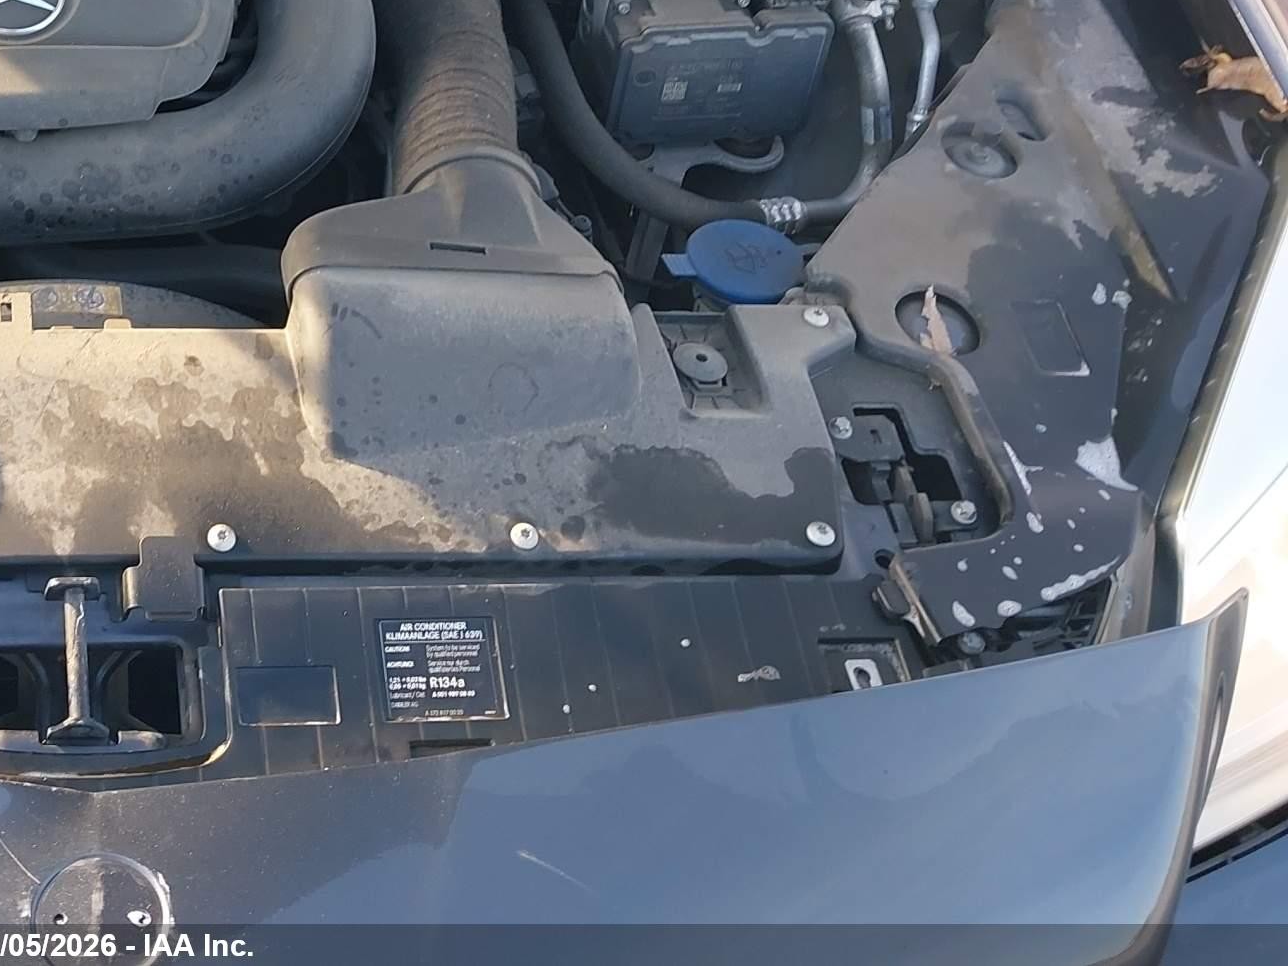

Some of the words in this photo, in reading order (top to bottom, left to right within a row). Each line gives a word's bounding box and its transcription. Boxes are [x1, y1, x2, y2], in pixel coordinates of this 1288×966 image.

[399, 622, 413, 632] AIR
[414, 621, 467, 631] CONDITIONER
[385, 631, 440, 640] KLIMAANLAGE
[441, 631, 459, 640] (SAE
[384, 645, 410, 653] CAUTION
[429, 676, 466, 689] R134a
